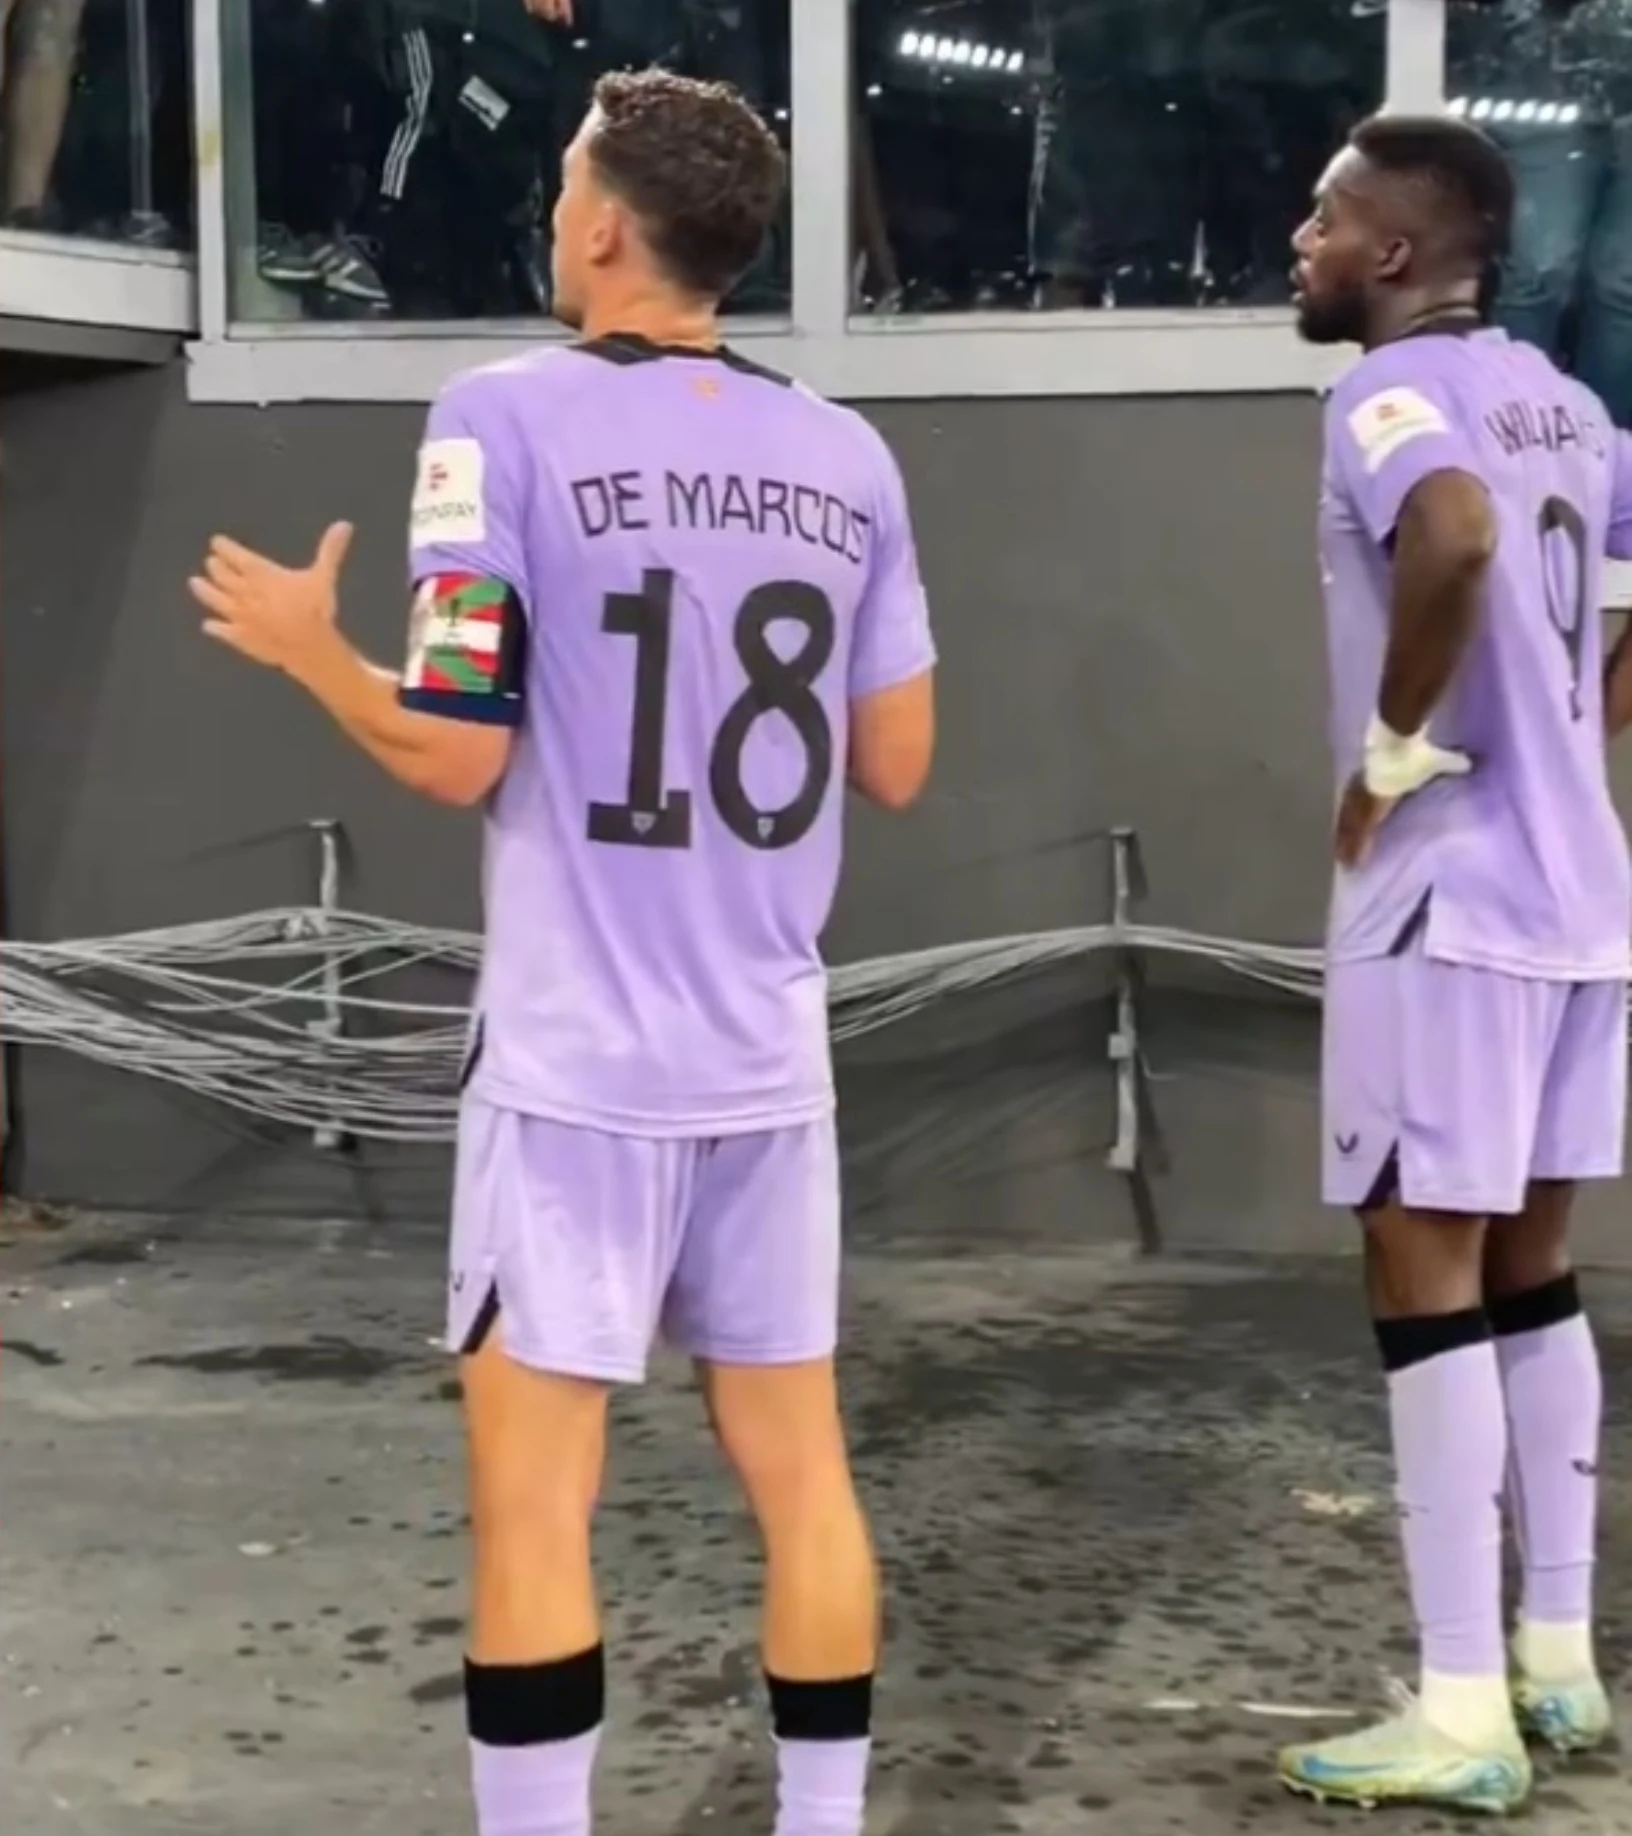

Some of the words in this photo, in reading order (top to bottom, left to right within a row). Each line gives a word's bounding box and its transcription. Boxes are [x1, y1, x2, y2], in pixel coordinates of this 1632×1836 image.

[571, 471, 652, 538] DE
[664, 472, 872, 565] MARCOS
[1538, 495, 1588, 722] 9
[586, 566, 836, 851] 18
